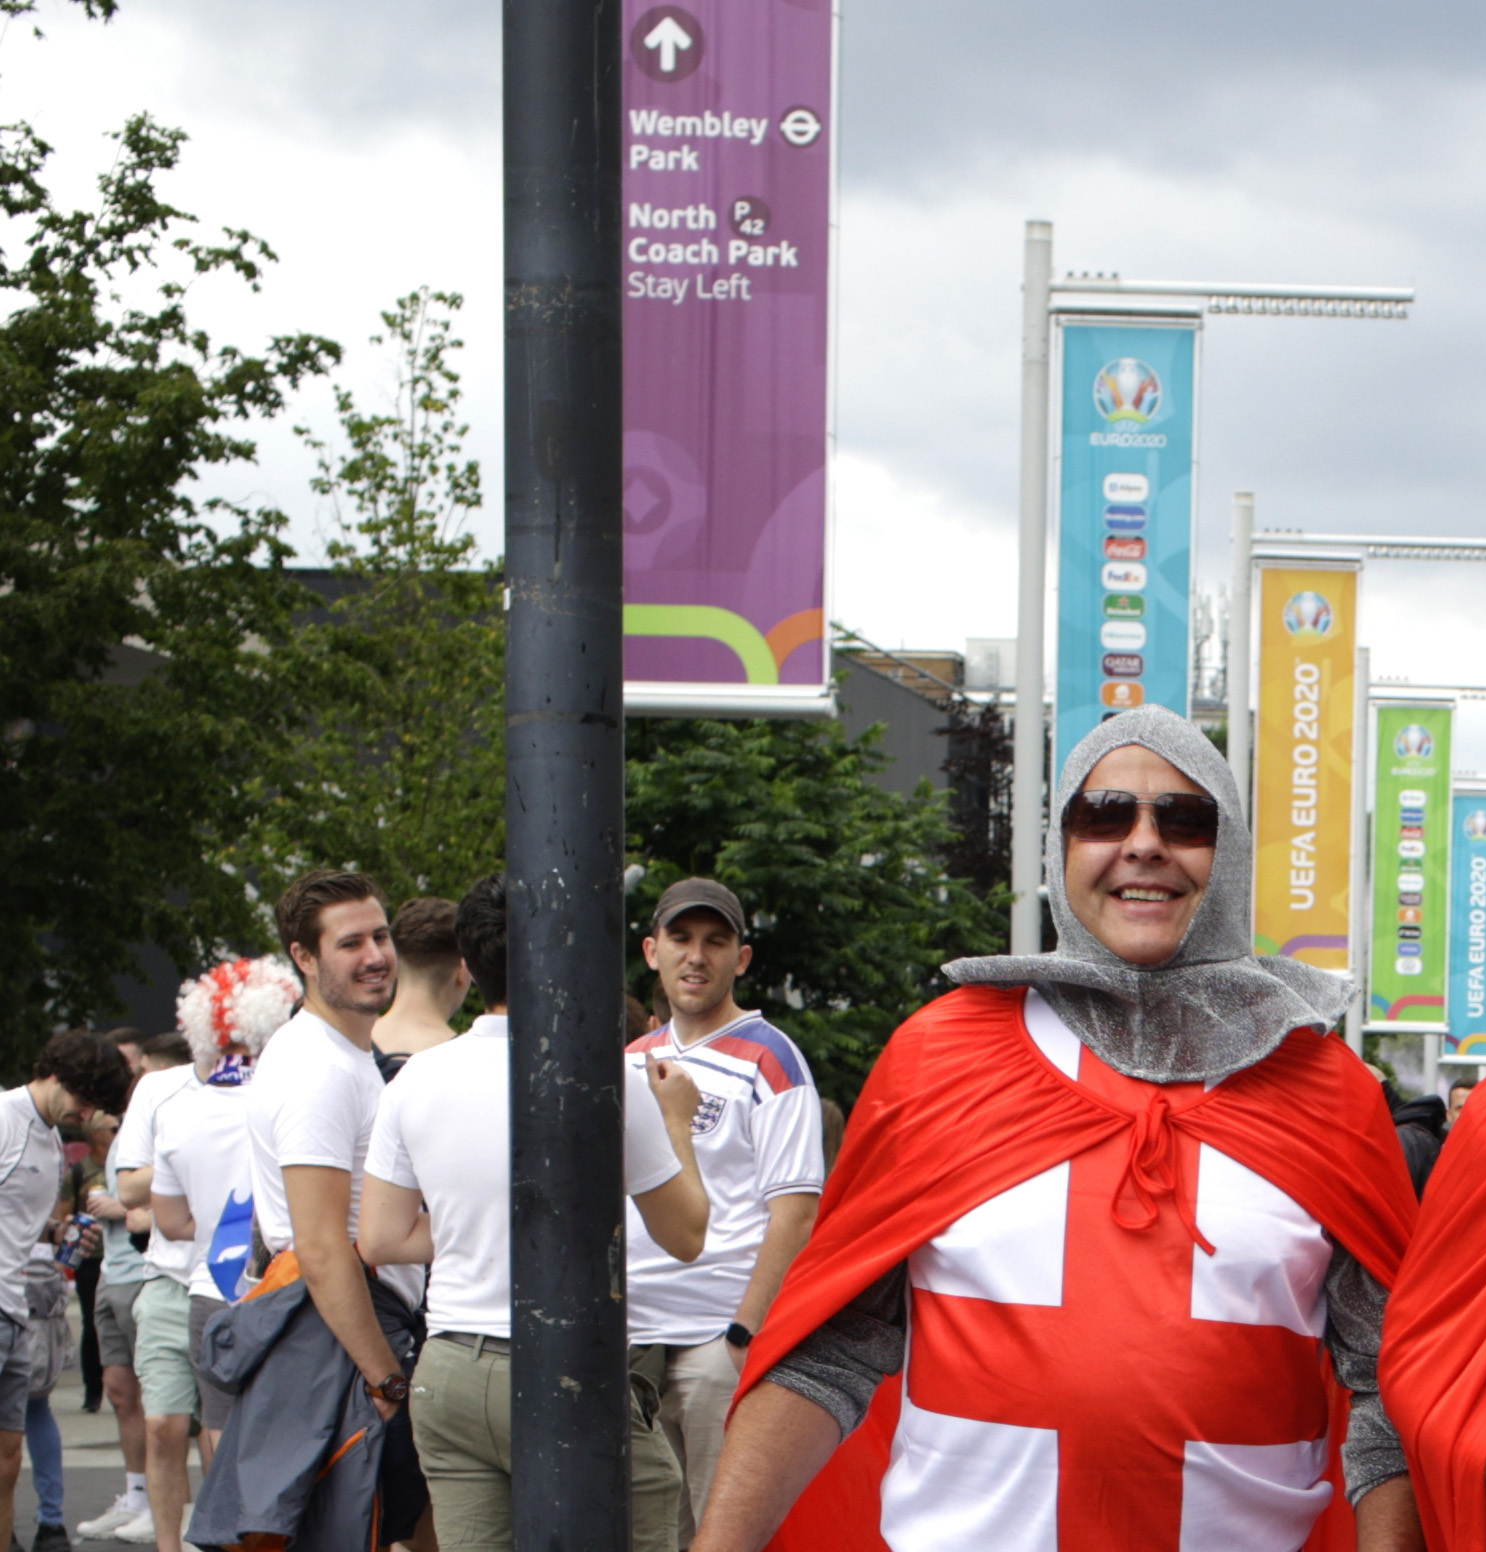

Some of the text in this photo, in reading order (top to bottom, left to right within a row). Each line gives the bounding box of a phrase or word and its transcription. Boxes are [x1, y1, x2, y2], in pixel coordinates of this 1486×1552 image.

[628, 109, 769, 146] Wembley
[629, 145, 700, 171] Park
[628, 200, 751, 229] North P
[738, 218, 765, 236] 42
[627, 236, 799, 268] Coach Park
[627, 270, 752, 306] Stay Left
[1290, 661, 1321, 911] UEFA EURO 2020
[1467, 965, 1486, 1018] UEFA
